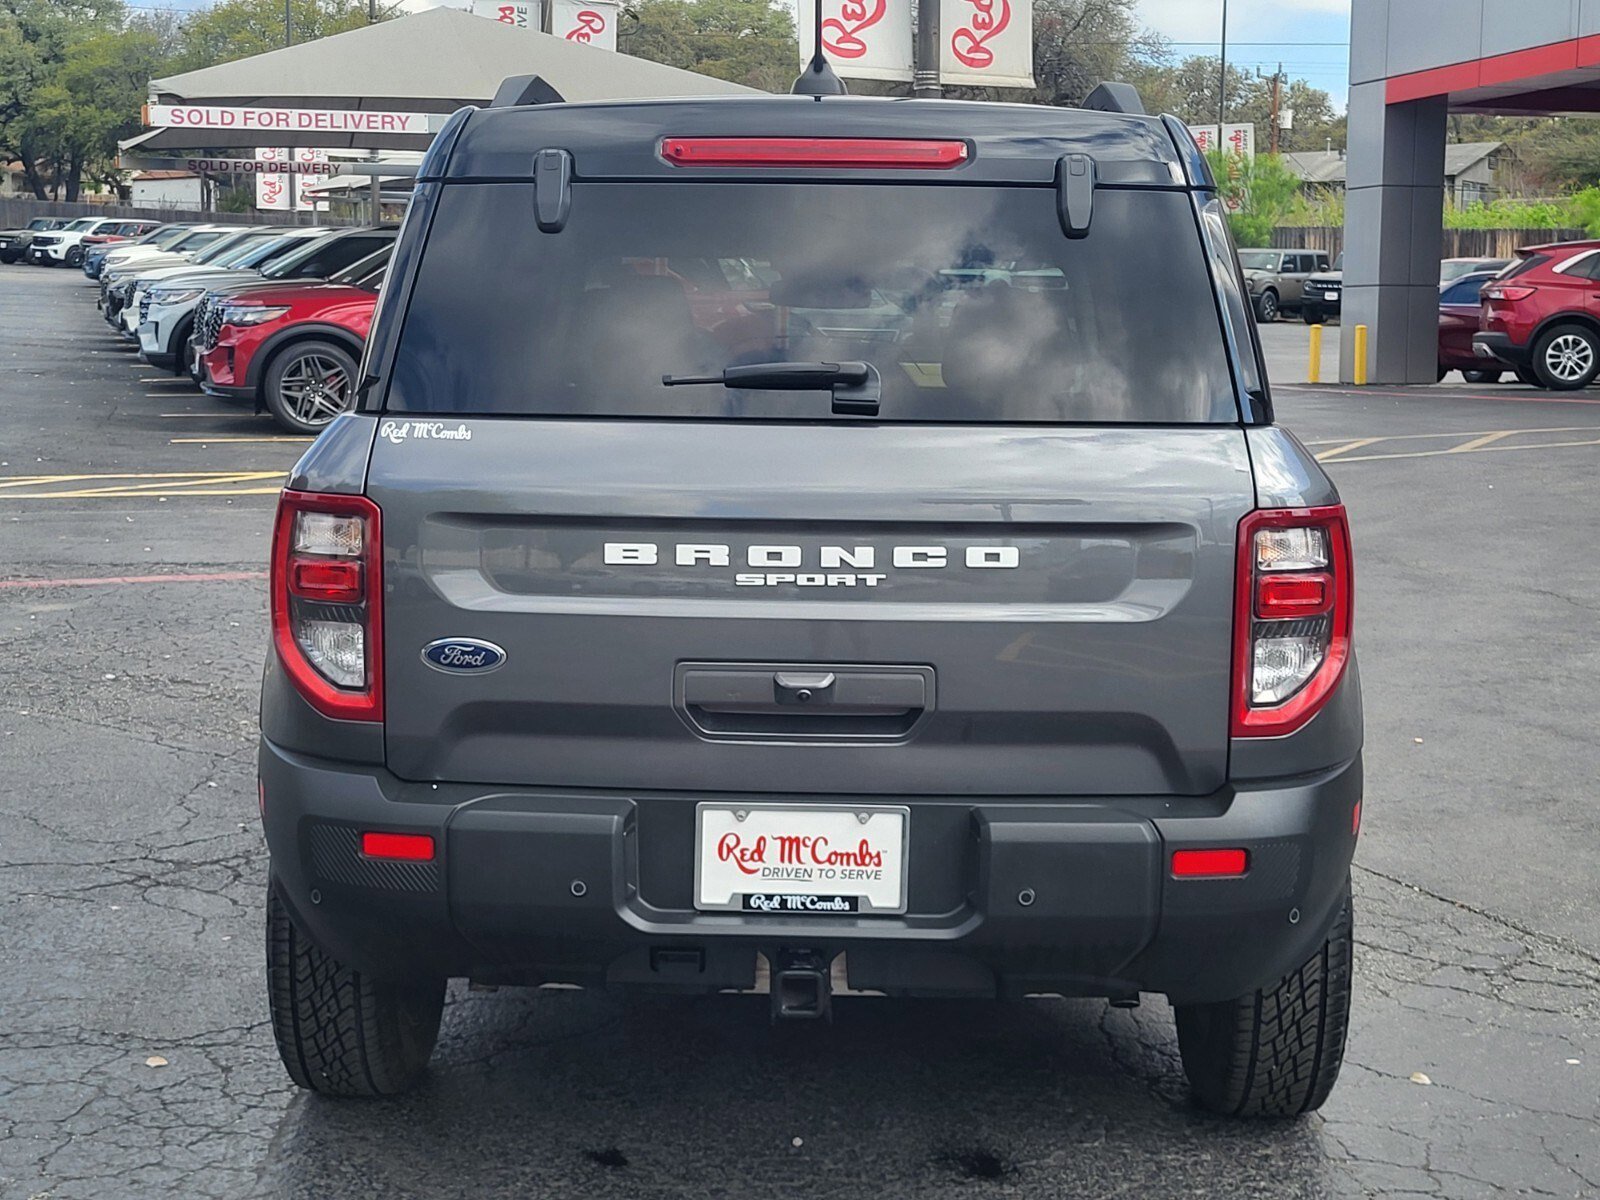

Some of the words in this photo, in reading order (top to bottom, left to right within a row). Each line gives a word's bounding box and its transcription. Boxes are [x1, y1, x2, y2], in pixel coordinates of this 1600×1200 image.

[565, 10, 605, 43] Re
[822, 0, 886, 59] Re
[170, 108, 236, 126] SOLD
[243, 110, 291, 128] FOR
[298, 112, 411, 131] DELIVERY
[188, 160, 229, 172] SOLD
[233, 161, 264, 173] FOR
[268, 162, 341, 174] DELIVERY
[262, 180, 283, 204] Red
[381, 421, 410, 444] Red
[411, 422, 472, 440] McCombs
[603, 542, 1021, 568] BRONCO
[735, 573, 887, 587] SPORT
[440, 645, 486, 666] Ford
[717, 832, 767, 875] Red
[771, 835, 883, 868] McCombs
[762, 867, 813, 879] DRIVEN
[817, 868, 836, 879] TO
[840, 869, 883, 880] SERVE
[750, 894, 781, 911] Red
[782, 895, 850, 911] McCombs
